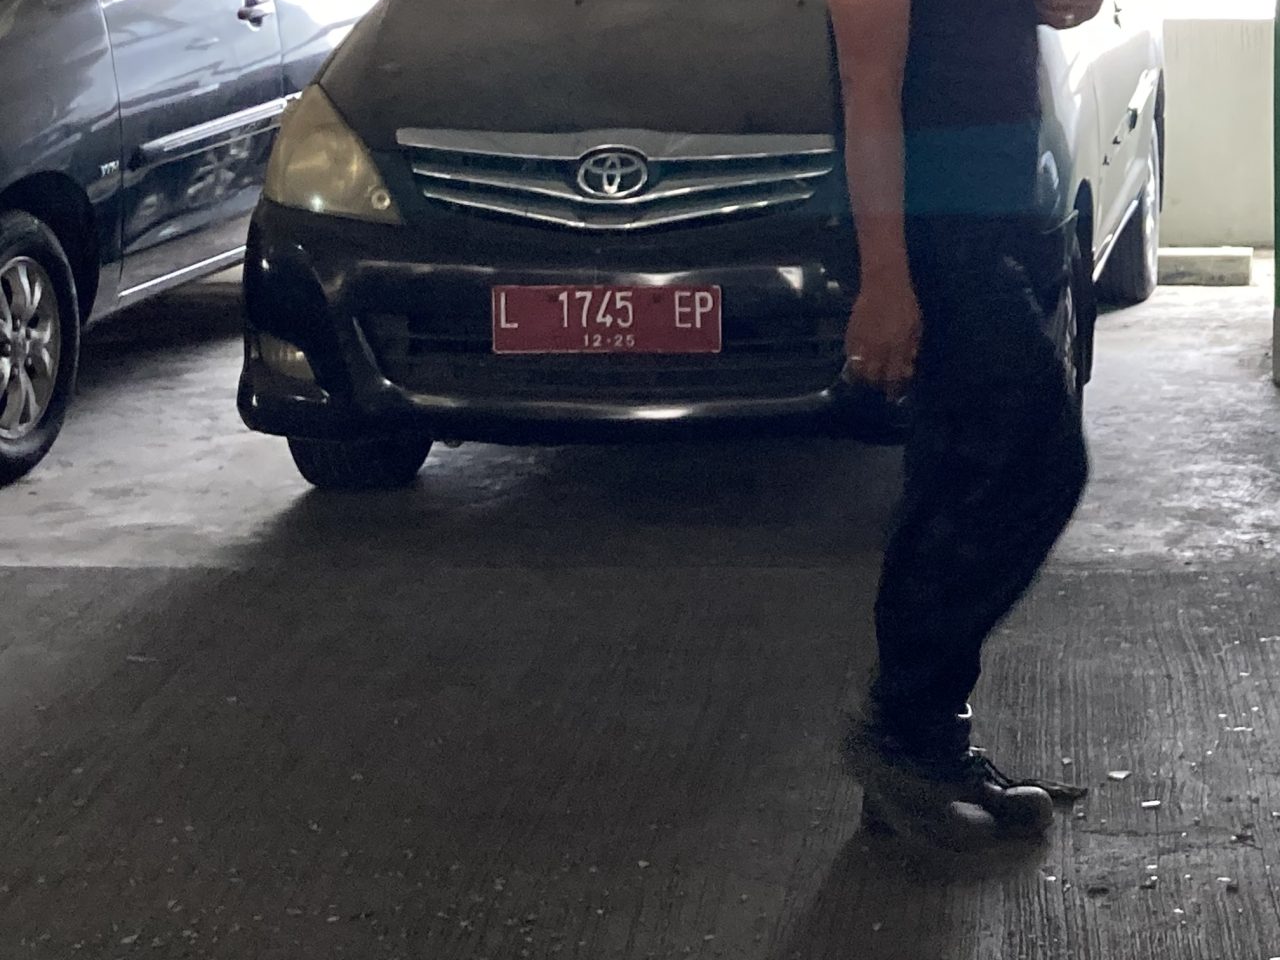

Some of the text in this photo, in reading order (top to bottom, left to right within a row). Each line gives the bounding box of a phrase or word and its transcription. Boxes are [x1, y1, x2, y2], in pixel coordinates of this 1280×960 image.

[500, 290, 714, 328] L 1745 EP
